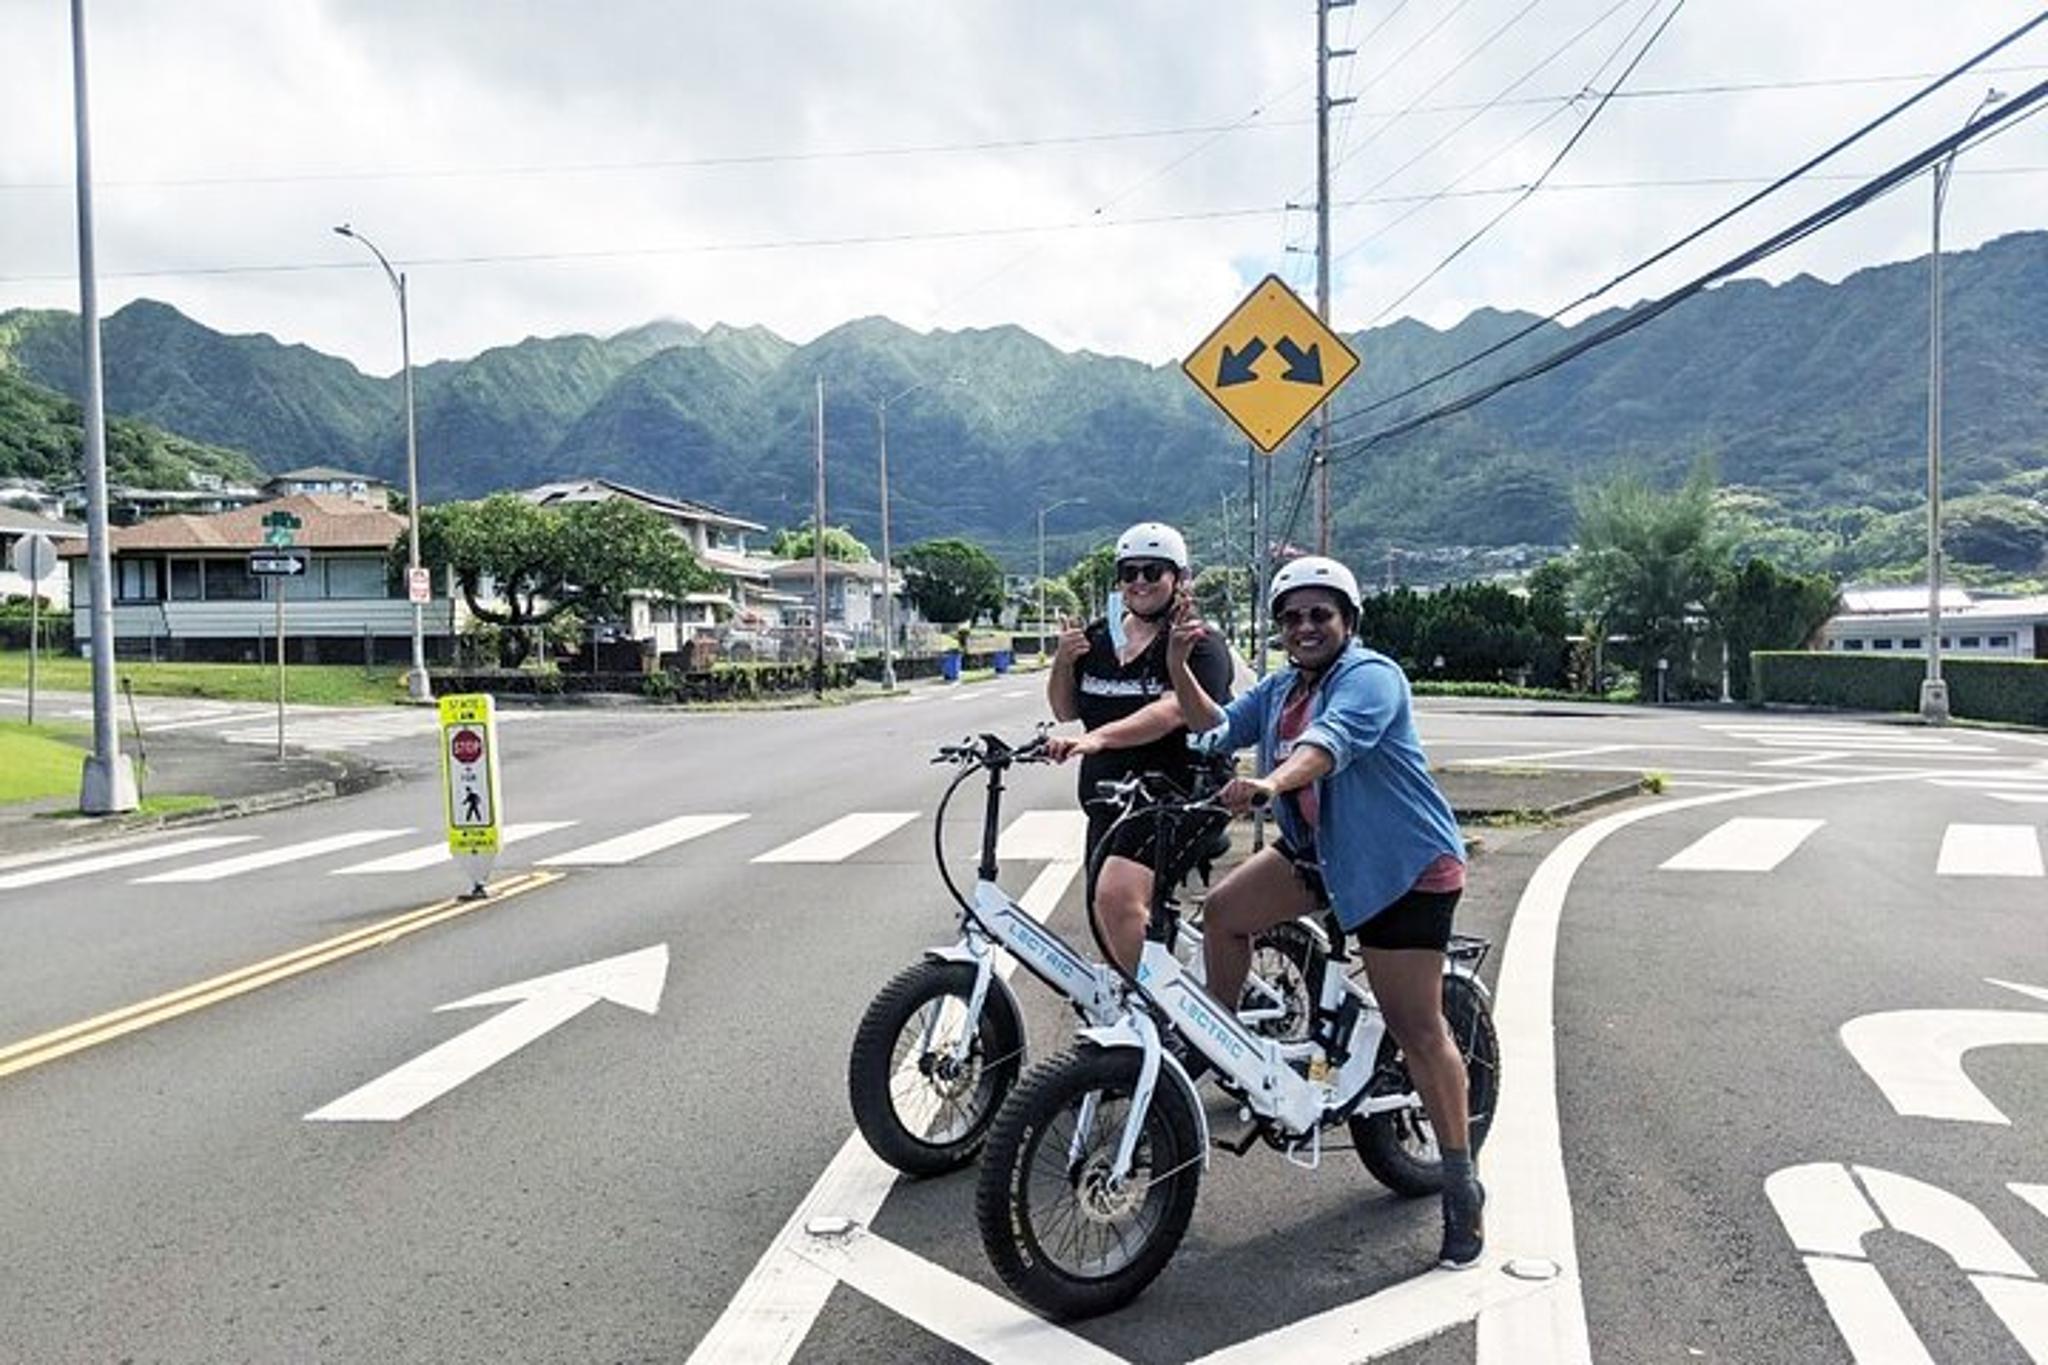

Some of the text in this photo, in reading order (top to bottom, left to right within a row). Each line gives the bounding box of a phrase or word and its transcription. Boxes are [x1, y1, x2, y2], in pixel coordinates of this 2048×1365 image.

[454, 740, 480, 755] STOP
[1008, 922, 1074, 978] LECTRIC
[1178, 994, 1245, 1059] LECTRIC
